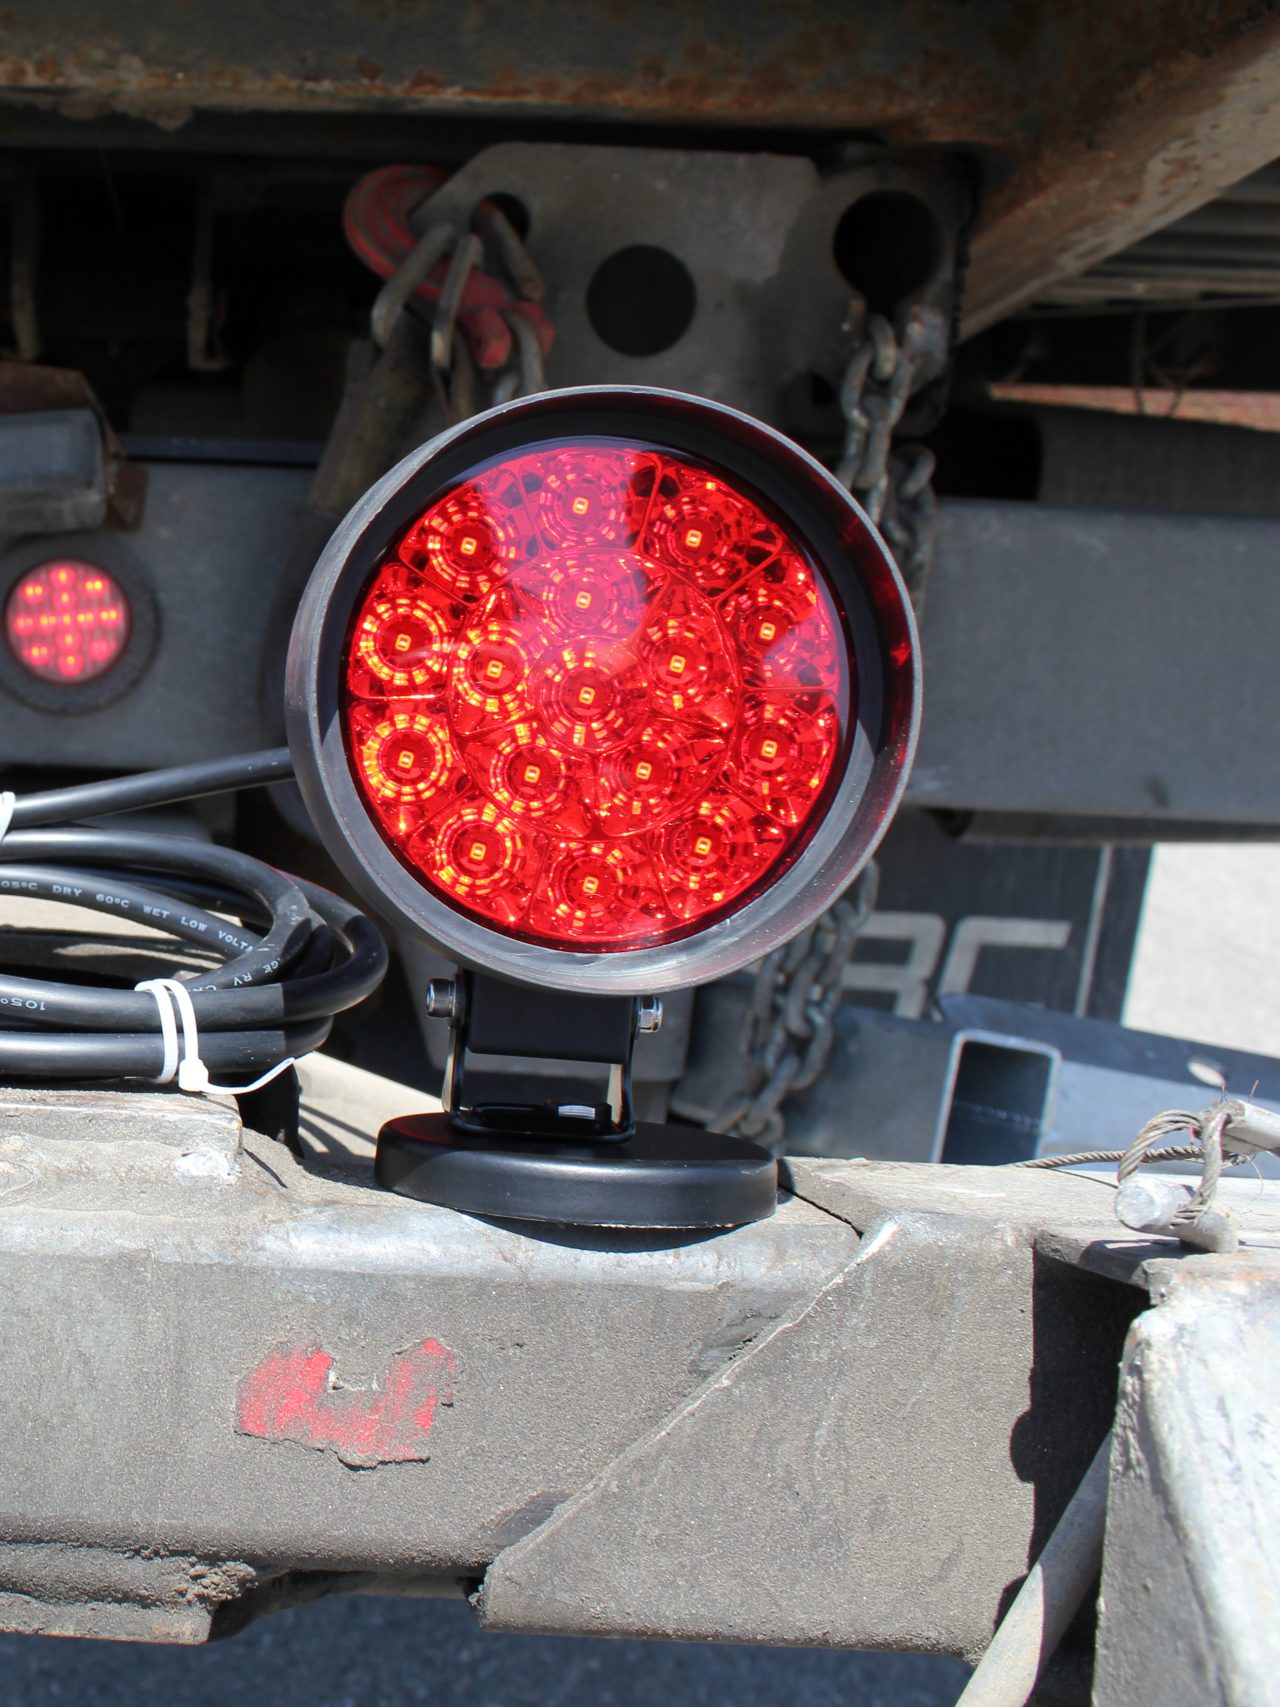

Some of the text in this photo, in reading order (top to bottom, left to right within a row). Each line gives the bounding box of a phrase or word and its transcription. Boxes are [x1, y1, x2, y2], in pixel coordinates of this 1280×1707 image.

[52, 884, 82, 897] DRY
[142, 904, 170, 919] WET
[180, 916, 208, 932] LOW
[233, 972, 253, 986] RV
